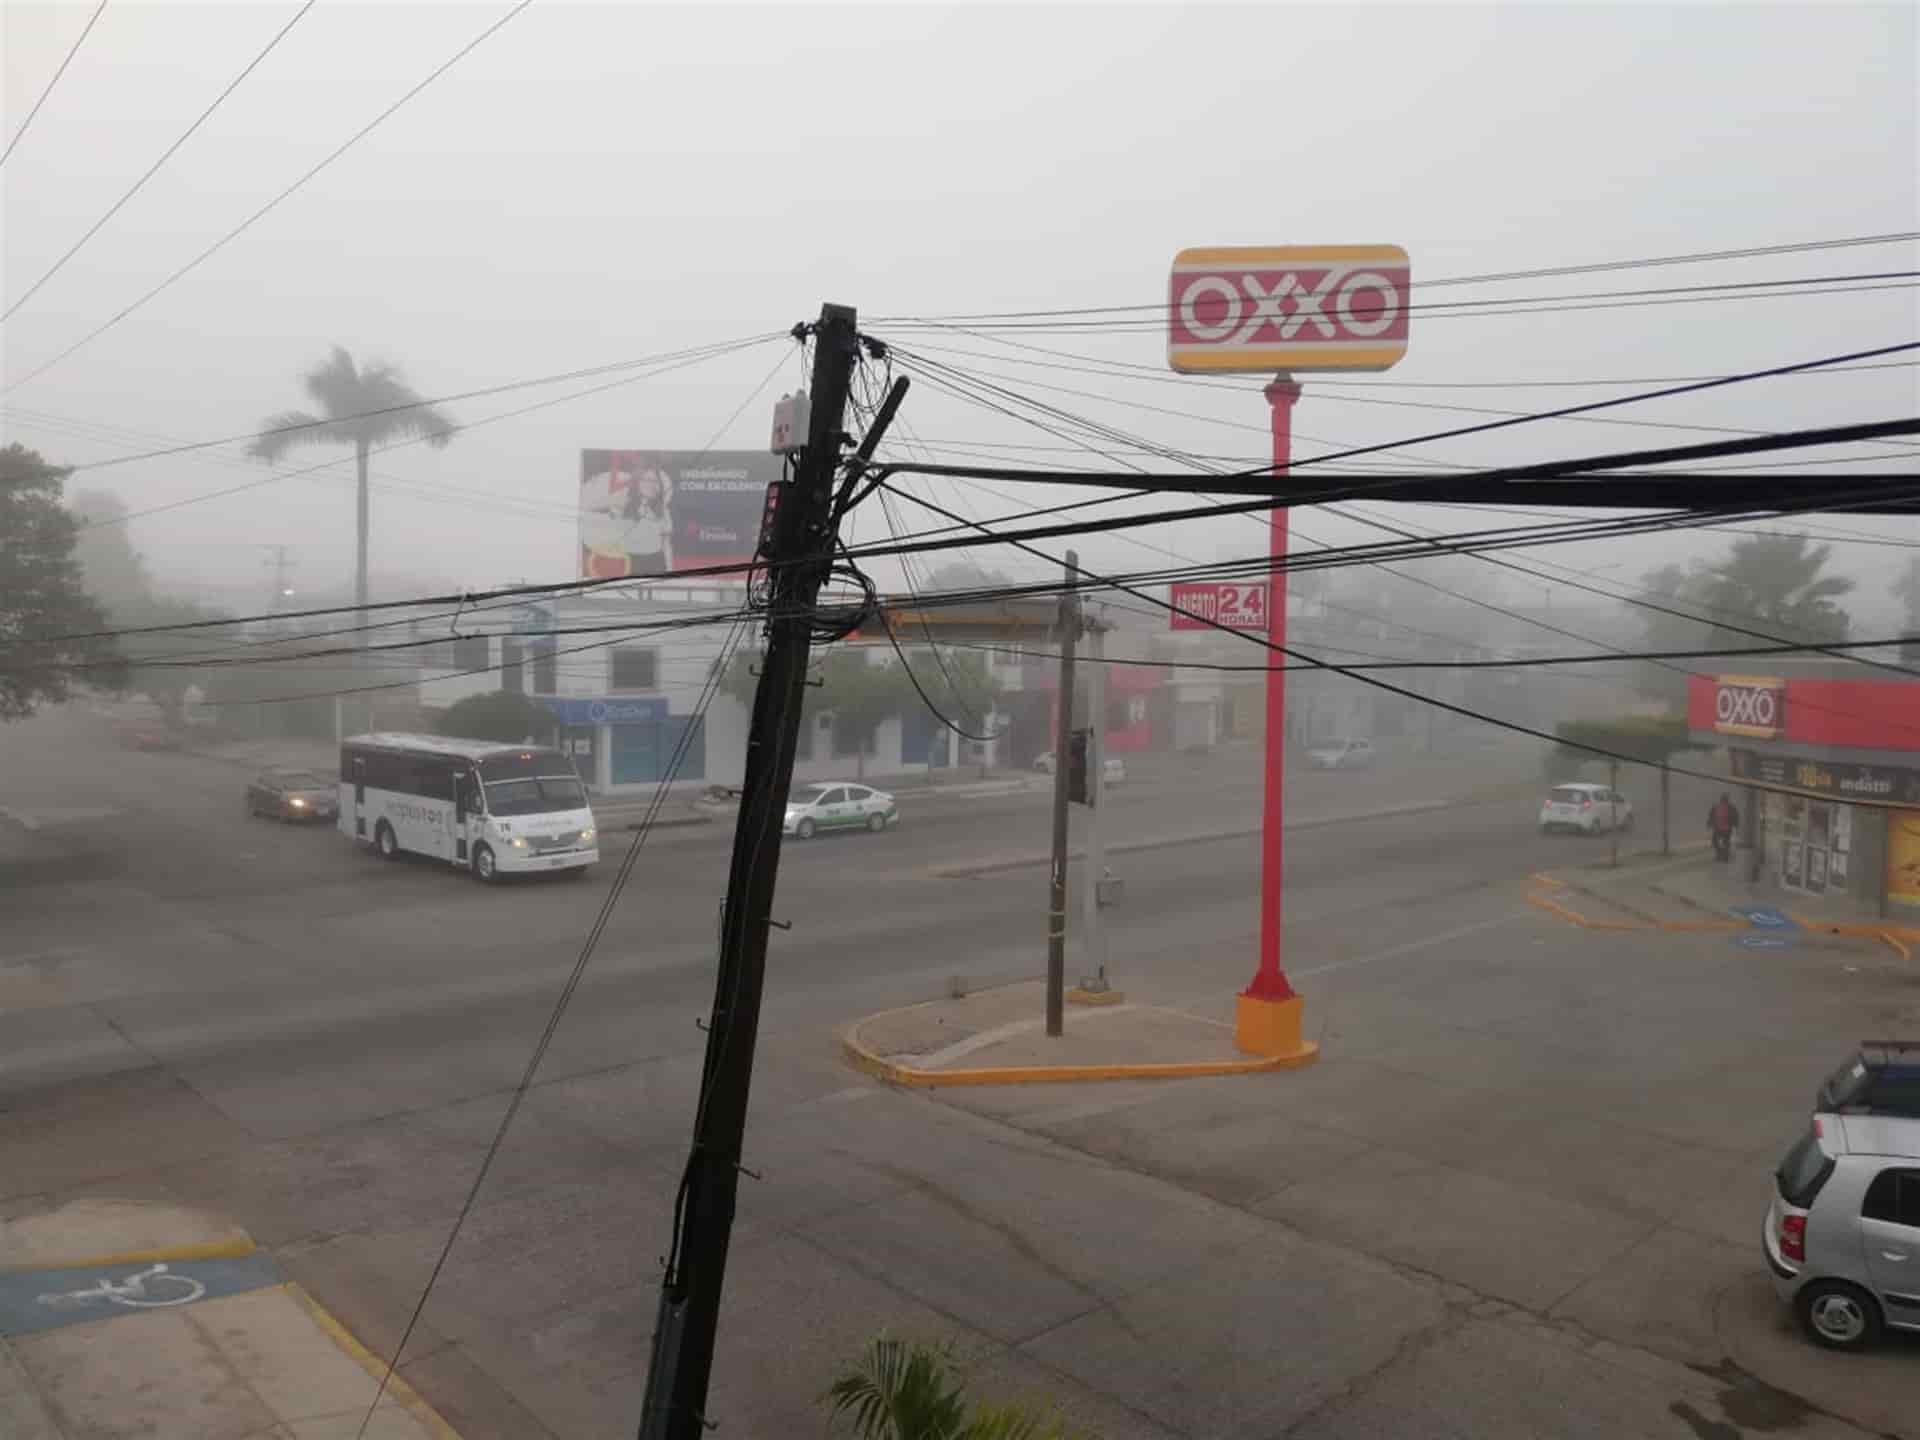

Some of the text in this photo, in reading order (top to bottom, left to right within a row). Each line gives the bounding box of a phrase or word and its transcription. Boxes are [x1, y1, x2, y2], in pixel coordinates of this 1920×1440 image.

[1179, 266, 1400, 344] OXXO
[1220, 589, 1263, 614] 24
[1219, 614, 1264, 625] HORAS
[1716, 687, 1776, 724] OXXO
